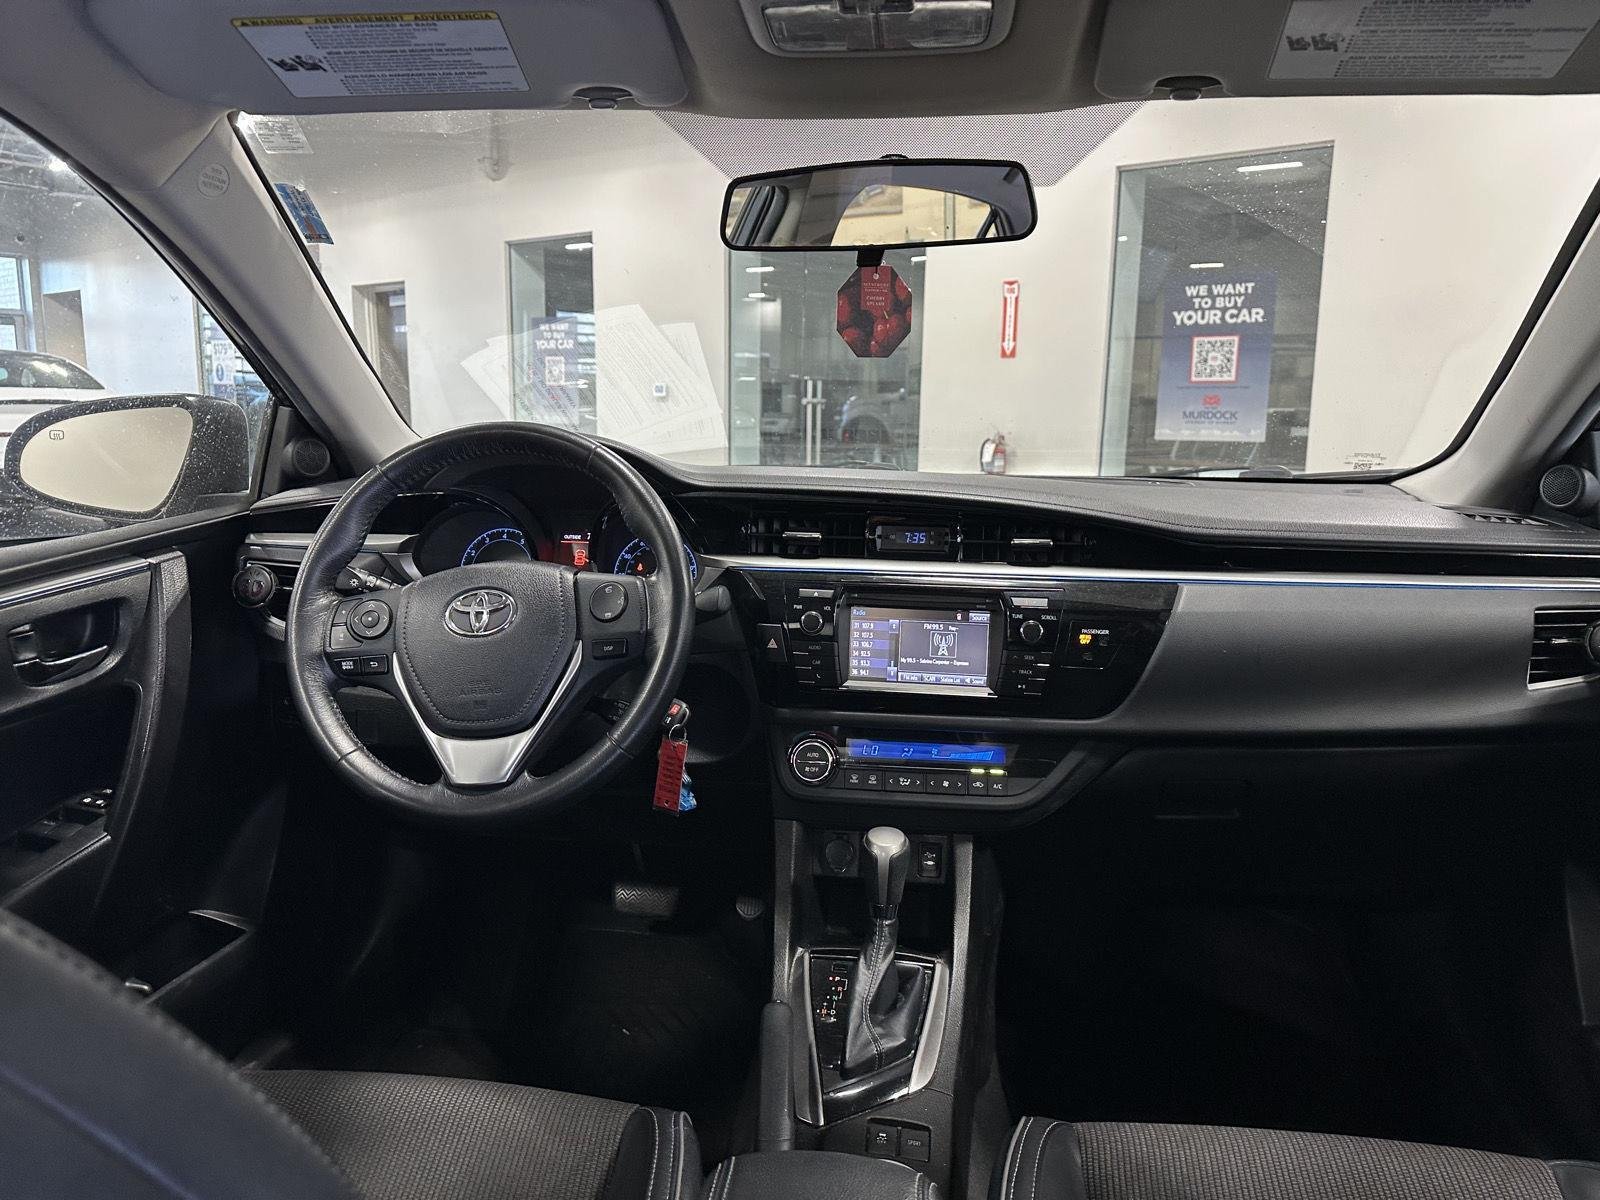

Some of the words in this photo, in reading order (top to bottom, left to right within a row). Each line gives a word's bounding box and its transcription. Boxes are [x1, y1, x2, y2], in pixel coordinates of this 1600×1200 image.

[1185, 284, 1209, 297] WE
[1211, 282, 1255, 295] WANT
[1192, 297, 1212, 309] TO
[1215, 295, 1245, 308] BUY
[1173, 309, 1222, 326] YOUR
[1224, 308, 1264, 323] CAR
[535, 339, 556, 350] YOUR
[557, 339, 575, 350] CAR
[1182, 410, 1238, 420] MURDOCK
[904, 532, 926, 544] 7:35
